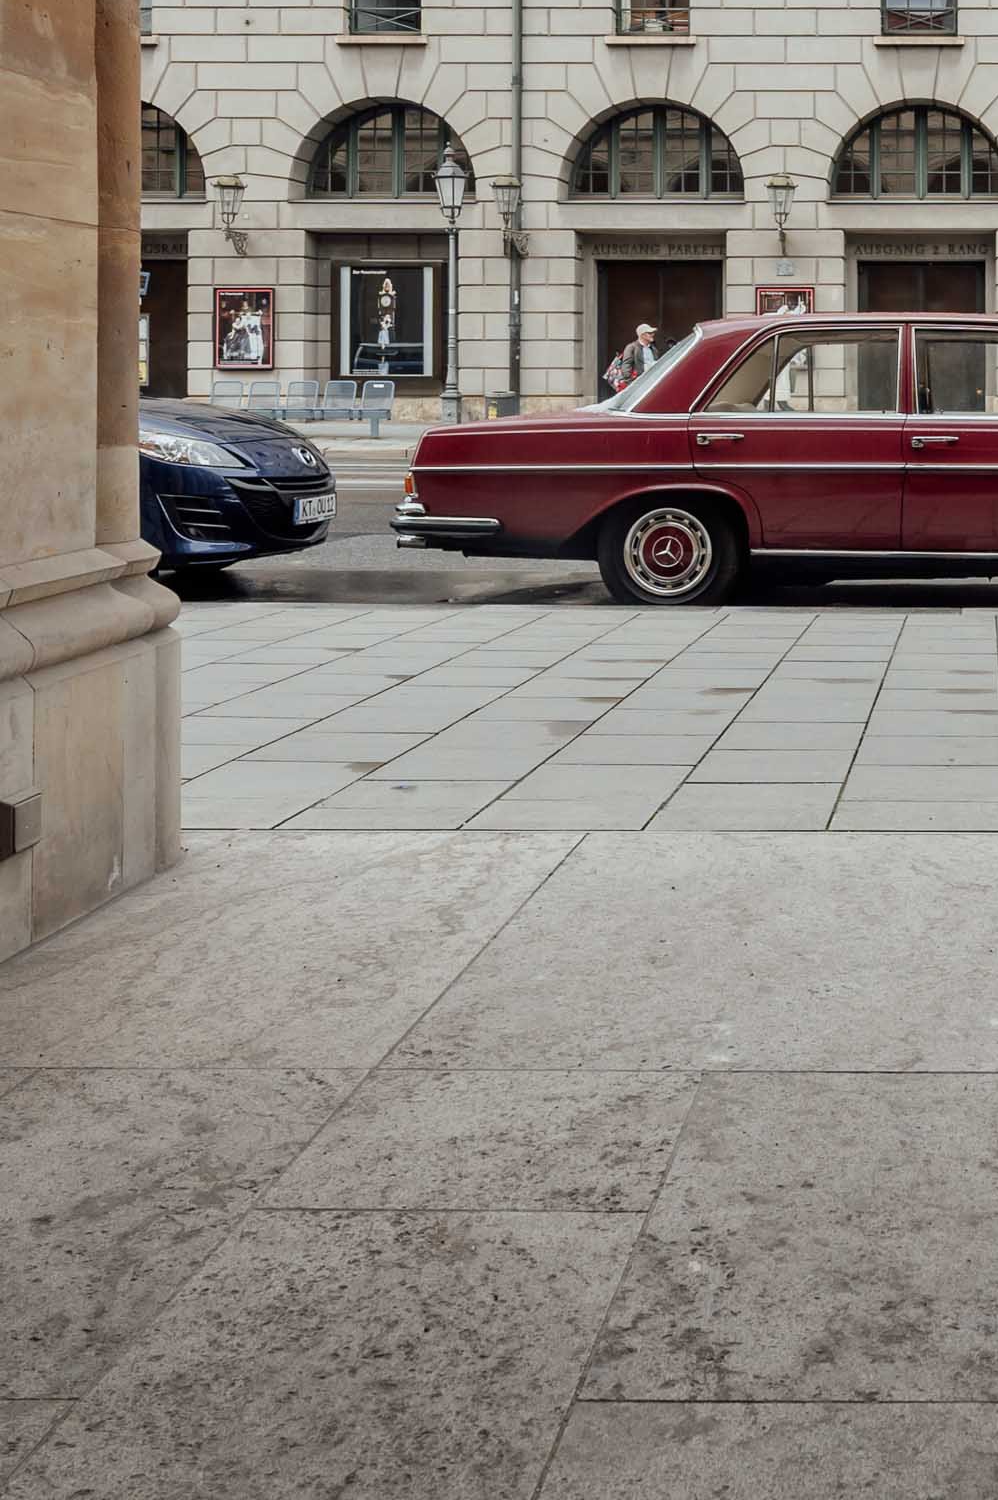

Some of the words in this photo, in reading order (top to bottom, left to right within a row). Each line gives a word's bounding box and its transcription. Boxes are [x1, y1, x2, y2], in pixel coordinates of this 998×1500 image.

[855, 243, 925, 255] AUSGANG
[948, 243, 990, 255] RANG
[302, 500, 313, 517] KT
